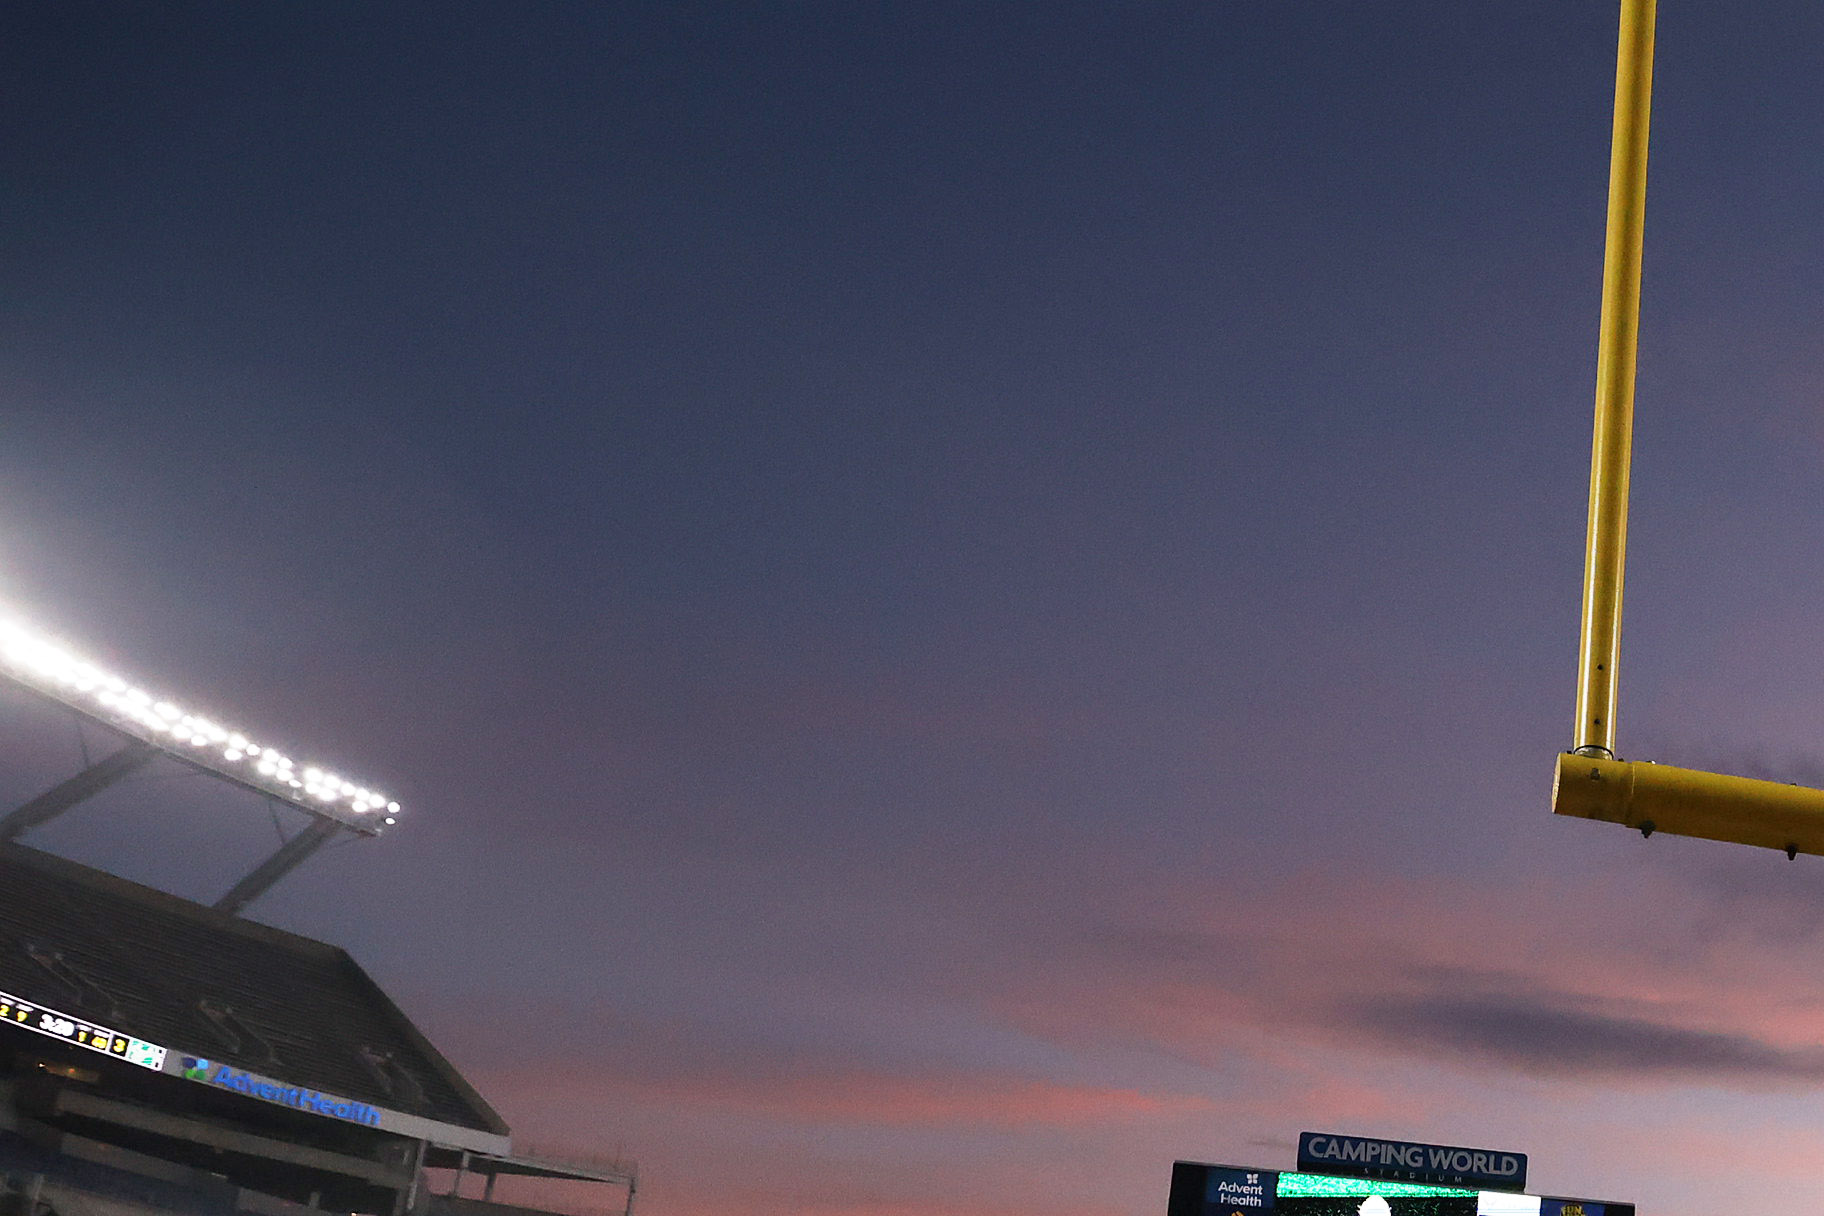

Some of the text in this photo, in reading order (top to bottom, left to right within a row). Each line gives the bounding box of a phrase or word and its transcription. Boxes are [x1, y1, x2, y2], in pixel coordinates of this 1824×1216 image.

[213, 1066, 382, 1126] AdventHealth
[1308, 1136, 1519, 1176] CAMPING WORLD
[1364, 1167, 1462, 1183] STADIUM
[1218, 1181, 1263, 1196] Advent
[1220, 1193, 1262, 1207] Health
